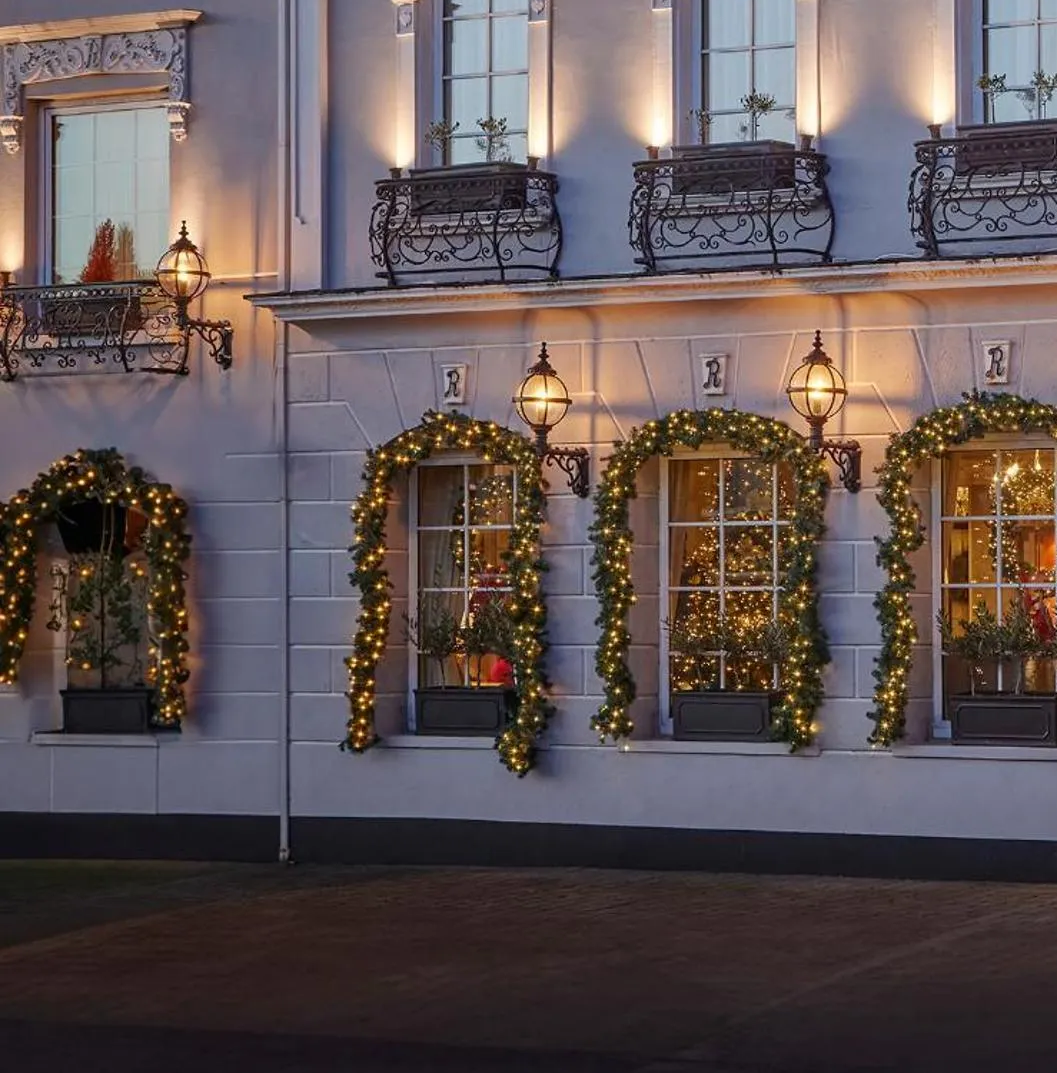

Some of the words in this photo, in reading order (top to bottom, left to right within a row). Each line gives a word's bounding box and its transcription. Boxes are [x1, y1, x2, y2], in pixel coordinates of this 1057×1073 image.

[702, 357, 722, 389] R
[984, 346, 1004, 378] R
[444, 368, 460, 398] R
